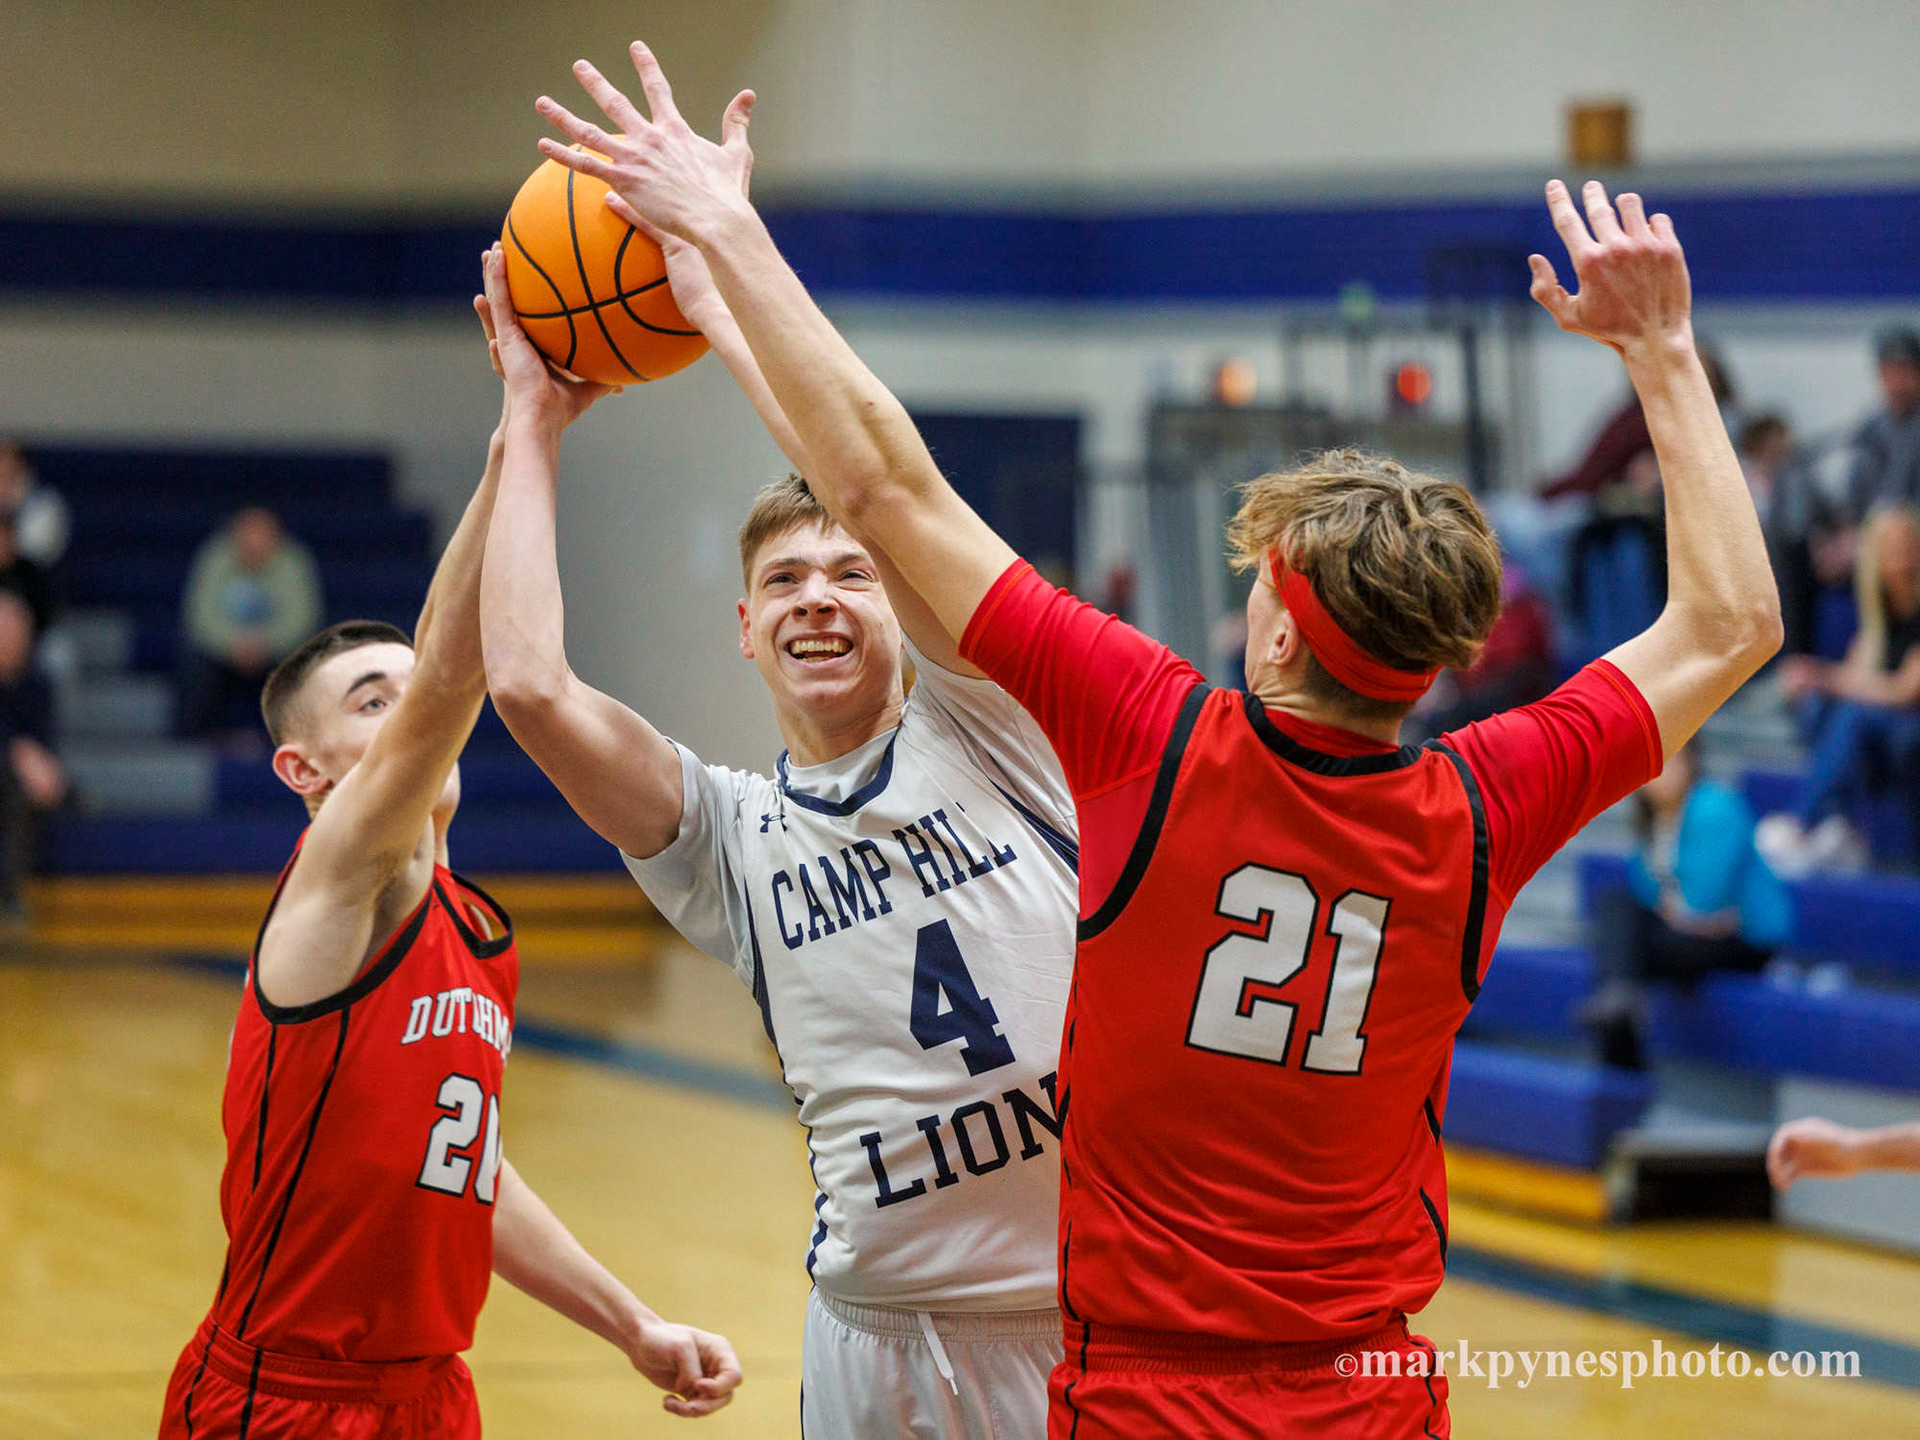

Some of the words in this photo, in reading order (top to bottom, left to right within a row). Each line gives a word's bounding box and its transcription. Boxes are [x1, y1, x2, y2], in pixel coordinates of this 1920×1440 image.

[771, 838, 893, 951] CAMP
[891, 802, 1018, 899] HILL
[909, 918, 1017, 1077] 4
[1184, 861, 1394, 1076] 21
[859, 1070, 1063, 1208] LION
